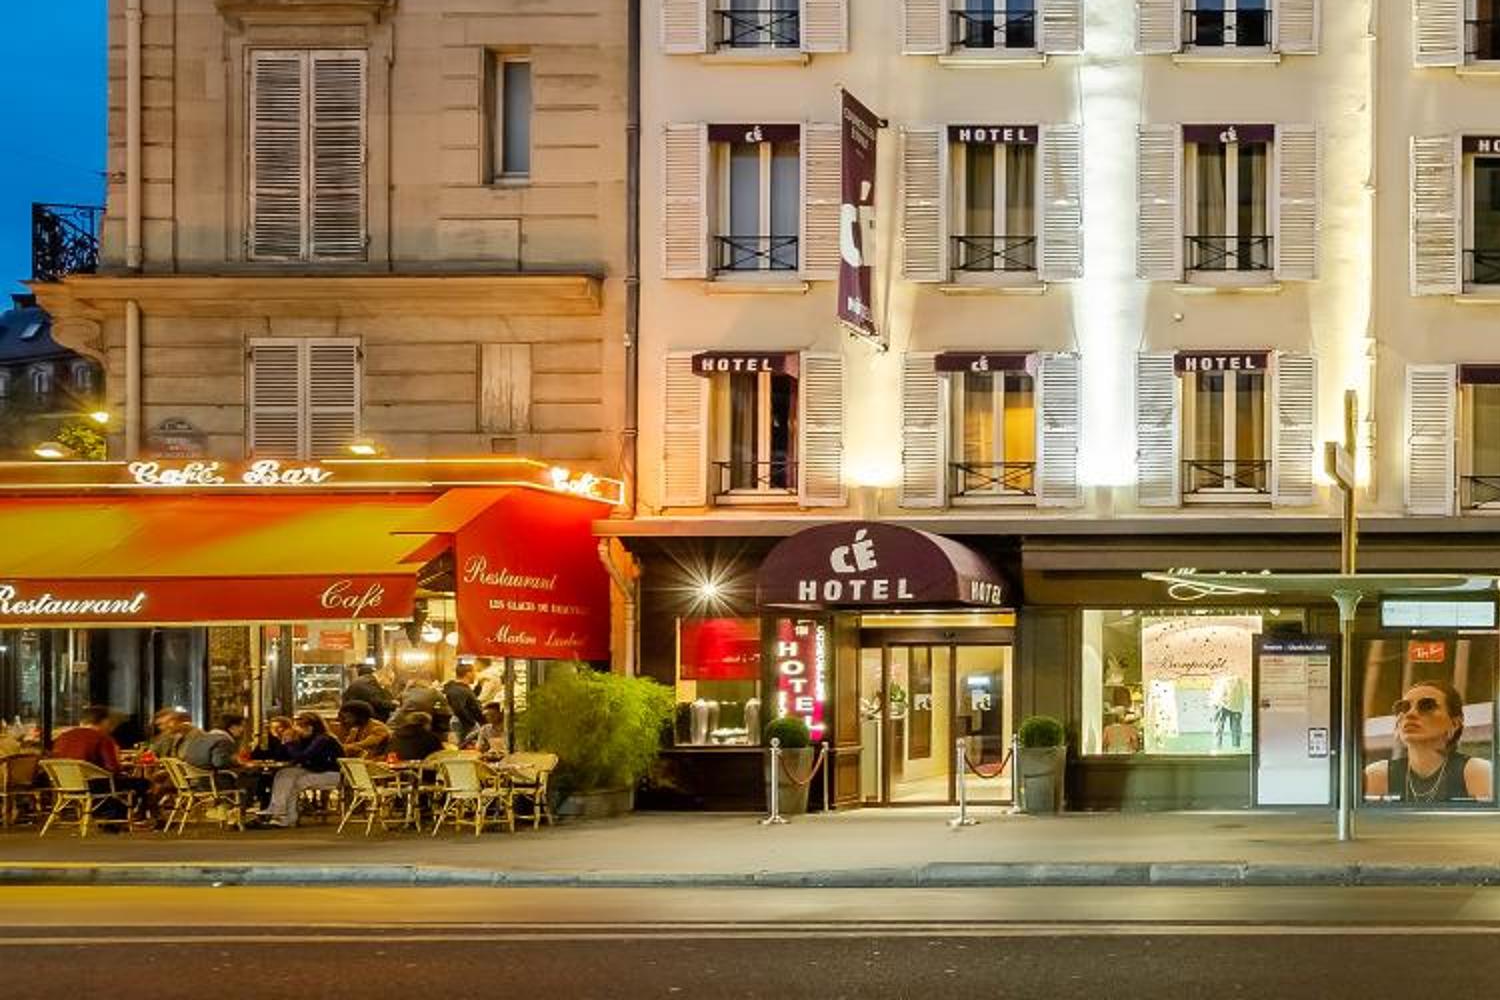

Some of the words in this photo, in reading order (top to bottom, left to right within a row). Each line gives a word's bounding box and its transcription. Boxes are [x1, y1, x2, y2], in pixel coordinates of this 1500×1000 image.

[960, 128, 1029, 142] HOTEL
[702, 357, 773, 371] HOTEL
[1185, 357, 1255, 371] HOTEL
[128, 461, 225, 484] Café
[243, 460, 334, 484] Bar
[830, 529, 877, 573] CÉ
[463, 555, 557, 590] Restaurant
[322, 580, 384, 618] Café
[799, 578, 915, 601] HOTEL
[778, 641, 826, 731] HOTEL
